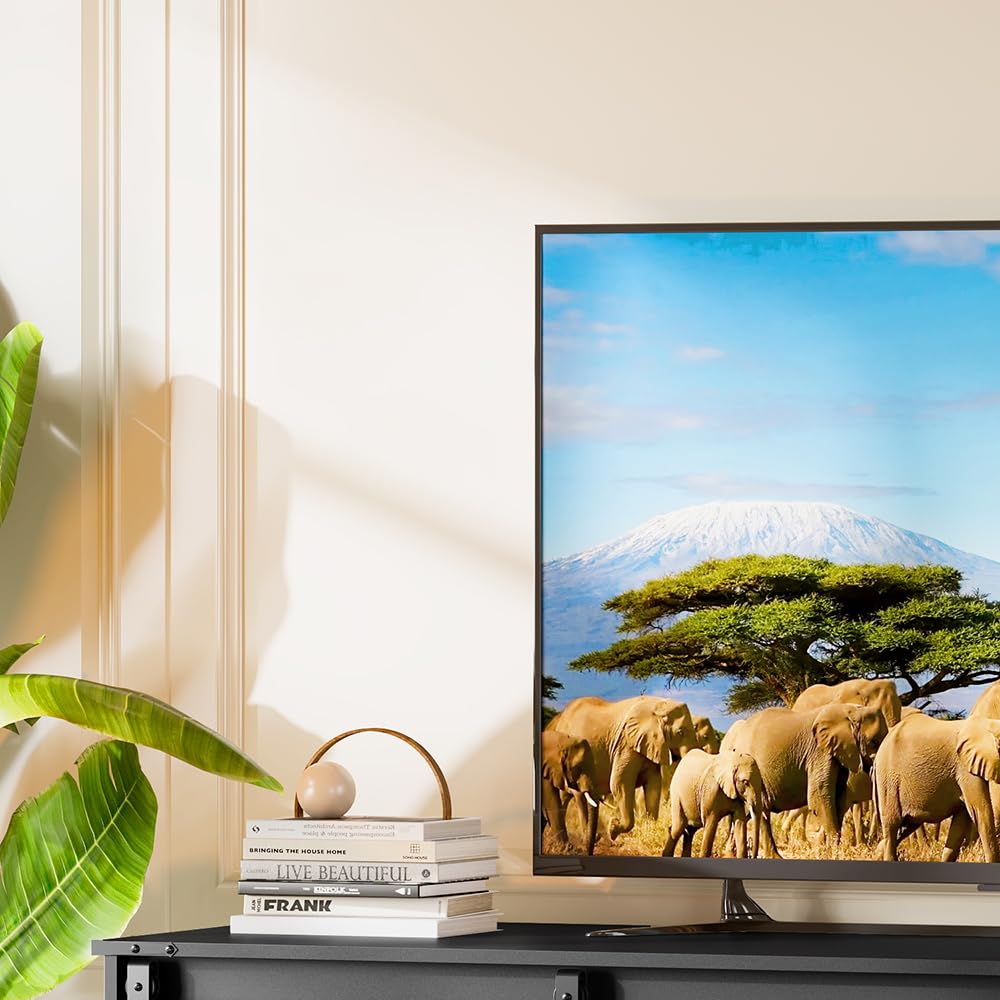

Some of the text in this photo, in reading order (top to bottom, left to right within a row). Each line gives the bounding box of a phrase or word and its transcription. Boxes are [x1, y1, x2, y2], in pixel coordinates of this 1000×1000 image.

[276, 864, 312, 880] LIVE
[318, 865, 412, 882] BEAUTIFUL
[264, 899, 333, 912] FRANK
